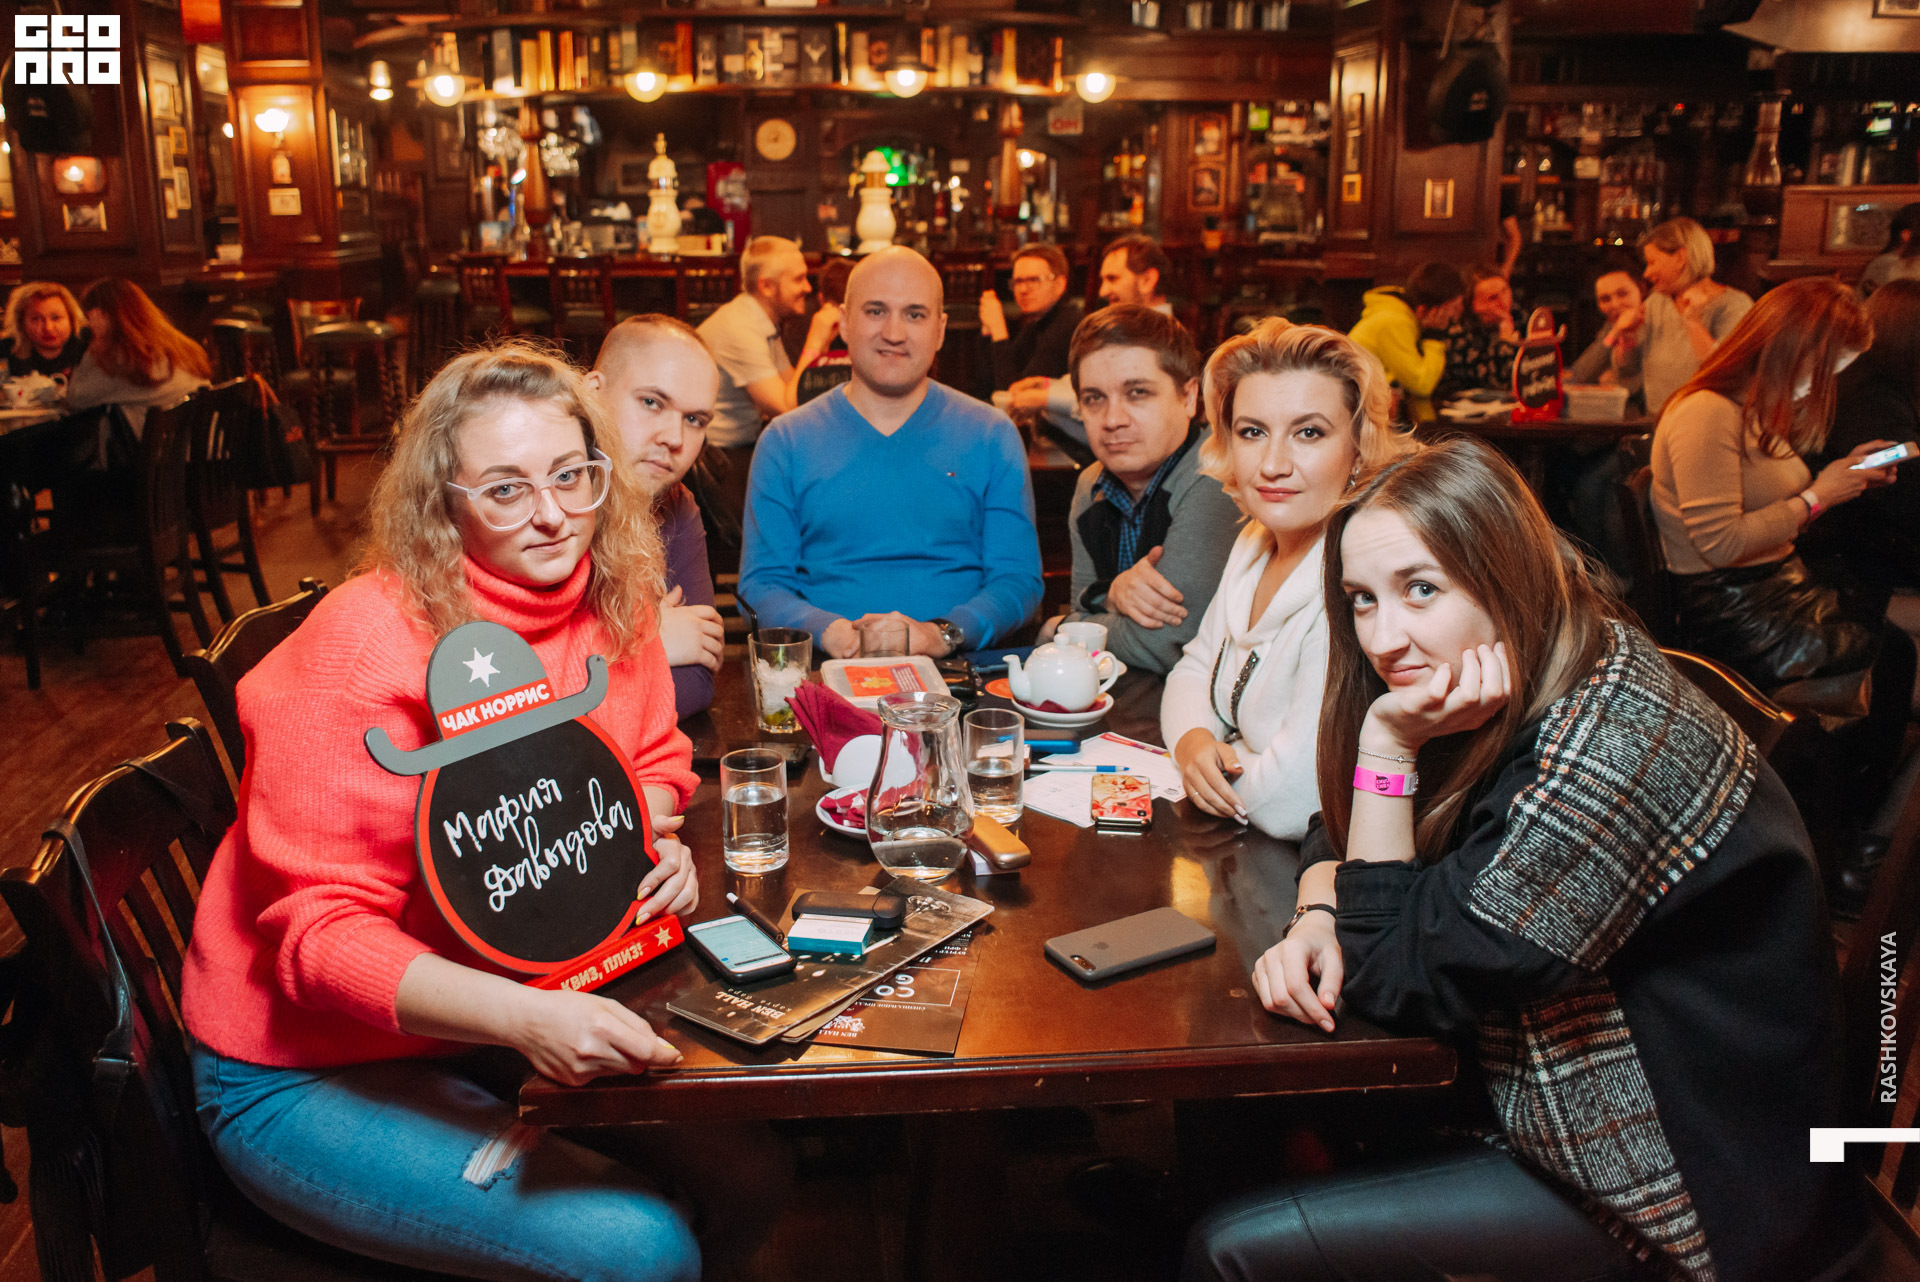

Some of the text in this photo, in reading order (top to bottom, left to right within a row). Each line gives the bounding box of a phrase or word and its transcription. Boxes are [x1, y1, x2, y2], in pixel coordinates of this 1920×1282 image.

[442, 684, 550, 731] ЧАК НОРРИС
[443, 778, 562, 858] Мафия
[602, 943, 644, 974] ПЛИЗ!
[715, 991, 786, 1020] BEN HALL
